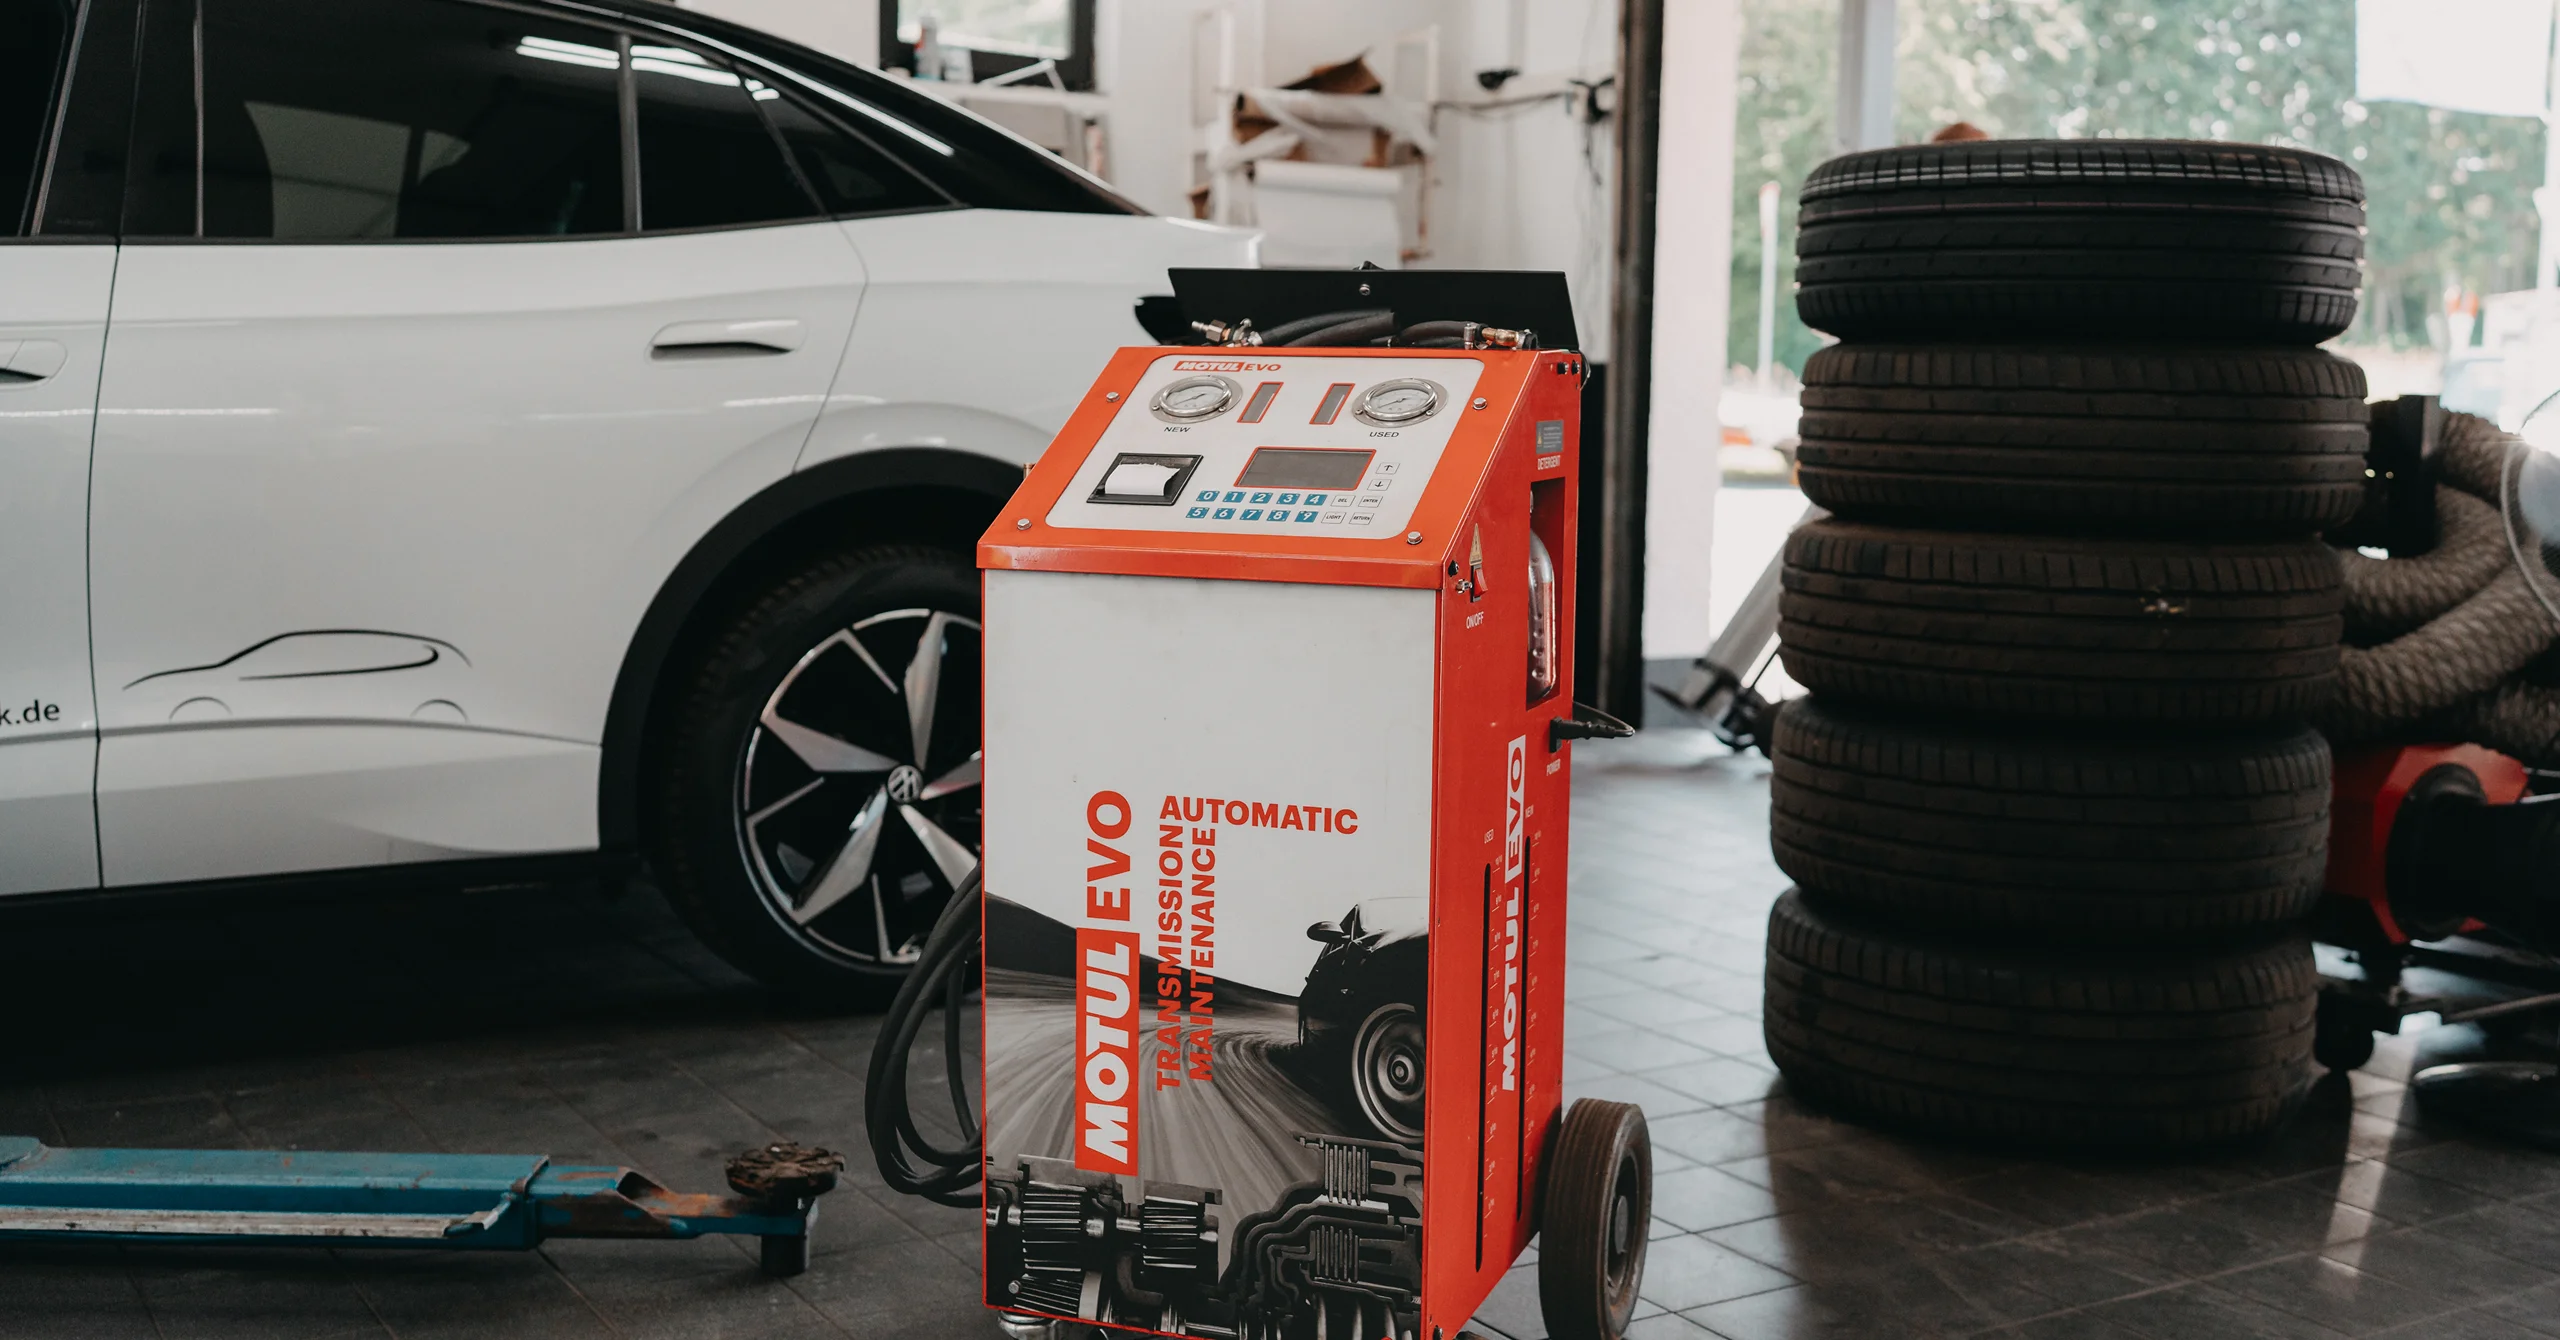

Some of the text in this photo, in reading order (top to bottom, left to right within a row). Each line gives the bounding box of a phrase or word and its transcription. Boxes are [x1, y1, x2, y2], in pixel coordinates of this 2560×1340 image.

[1176, 361, 1282, 372] MOTUL EVO
[1192, 508, 1202, 517] 5
[1220, 509, 1228, 517] 6
[1247, 510, 1257, 518] 7
[1273, 511, 1283, 520] 8
[1303, 512, 1313, 521] 9
[1203, 491, 1213, 500] 0
[1255, 493, 1267, 502] 2
[1283, 494, 1293, 503] 3
[1310, 495, 1320, 504] 4
[1159, 795, 1359, 835] AUTOMATIC
[1083, 790, 1132, 1165] MOTUL EVO
[1156, 823, 1184, 1092] TRANSMISSION
[1189, 827, 1216, 1082] MAINTENANCE
[1502, 746, 1522, 1091] MOTUL EVO
